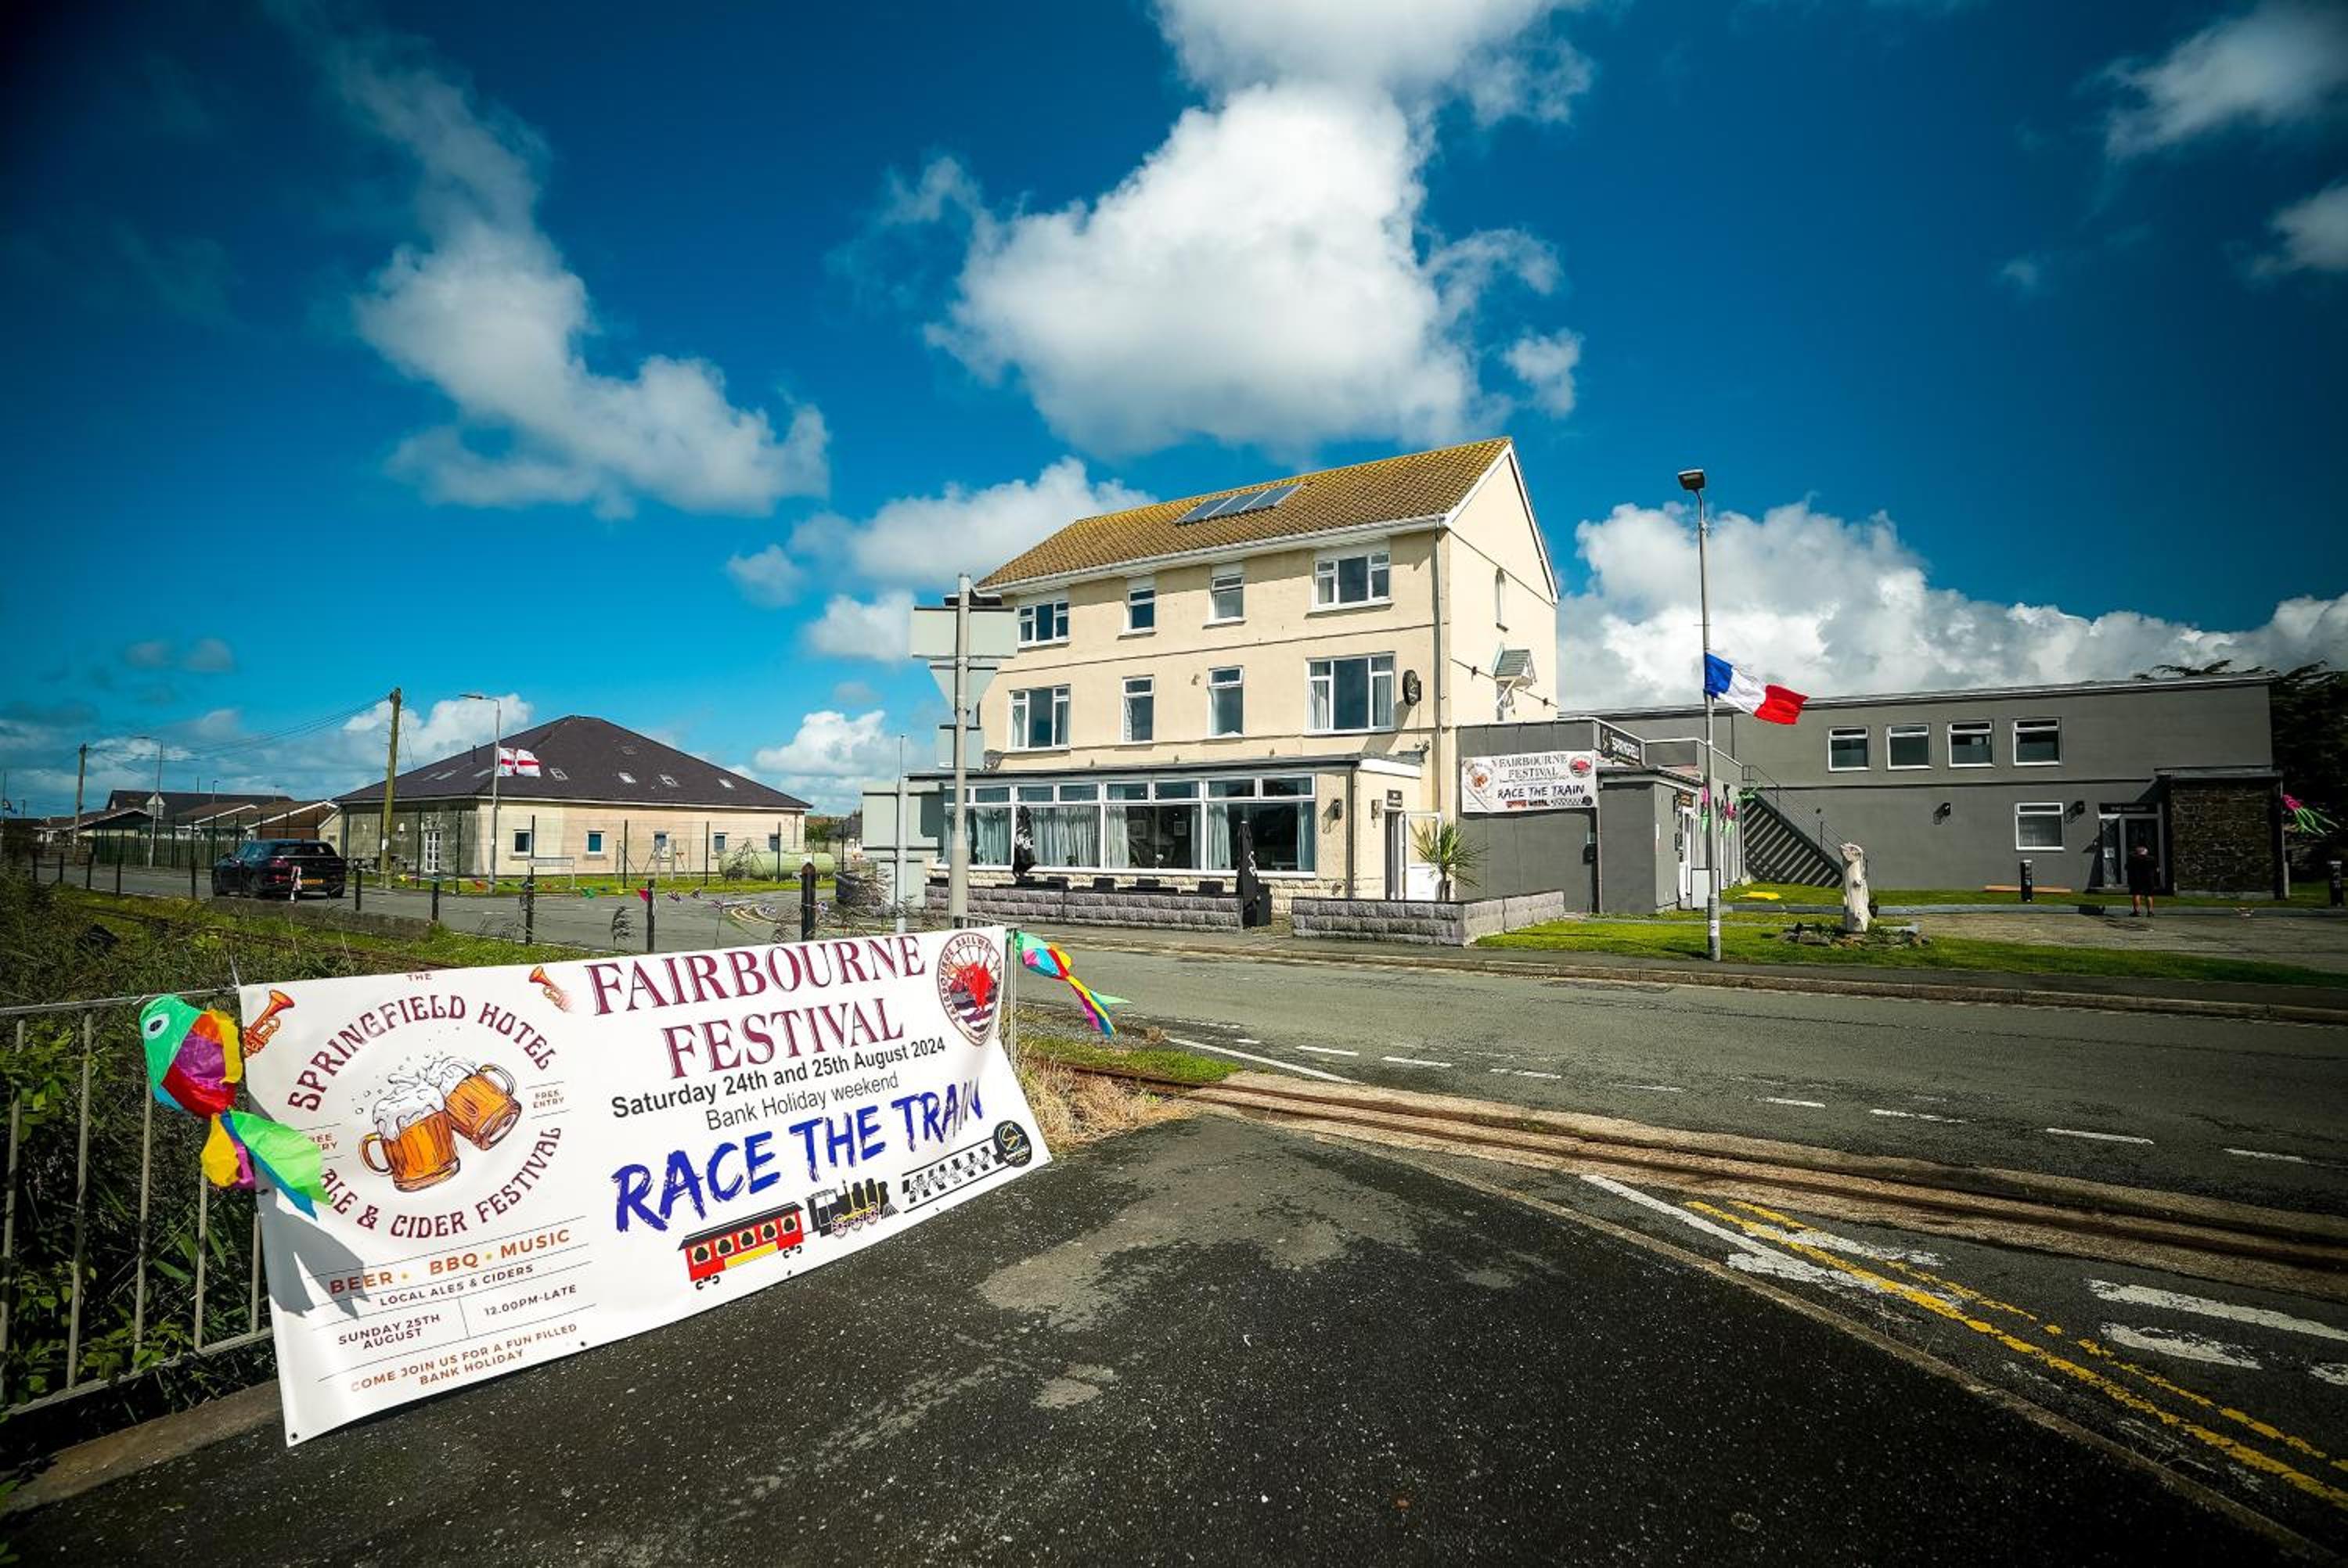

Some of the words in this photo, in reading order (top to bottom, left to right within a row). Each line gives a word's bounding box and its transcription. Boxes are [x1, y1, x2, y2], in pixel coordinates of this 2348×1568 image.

[1497, 754, 1568, 768] FAIRBOURNE
[1507, 767, 1558, 779] FESTIVAL
[1497, 788, 1525, 800] RACE
[1529, 786, 1548, 797] THE
[1552, 785, 1585, 797] TRAIN
[406, 973, 432, 982] THE
[585, 935, 927, 1016] FAIRBOURNE
[287, 994, 466, 1112] SPRINGFIELD
[477, 1002, 556, 1070] HOTEL
[660, 997, 905, 1080] FESTIVAL
[535, 1088, 560, 1099] FREE
[611, 1082, 717, 1118] Saturday
[723, 1070, 769, 1095] 24th
[773, 1063, 808, 1085] and
[812, 1054, 850, 1078] 25th
[853, 1045, 909, 1070] August
[911, 1036, 946, 1058] 2024
[533, 1096, 564, 1108] ENTRY
[706, 1102, 758, 1130] Bank
[762, 1088, 827, 1117] Holiday
[830, 1071, 899, 1102] weekend
[610, 1131, 781, 1232] RACE
[788, 1105, 886, 1182] THE
[891, 1077, 984, 1153] TRAIN
[321, 1168, 358, 1214] ALE
[356, 1204, 380, 1230] &
[391, 1211, 468, 1239] CIDER
[475, 1127, 561, 1224] FESTIVAL
[330, 1271, 394, 1295] BEER
[429, 1253, 479, 1275] BBQ
[500, 1229, 571, 1259] MUSIC
[380, 1291, 426, 1306] LOCAL
[430, 1282, 465, 1296] ALES
[469, 1278, 477, 1288] &
[482, 1264, 534, 1284] CIDERS
[338, 1322, 402, 1345] SUNDAY
[405, 1314, 441, 1329] 25TH
[362, 1329, 423, 1350] AUGUST
[351, 1372, 396, 1392] COME
[400, 1360, 435, 1378] JOIN
[438, 1354, 458, 1366] US
[462, 1347, 489, 1361] FOR
[493, 1343, 503, 1354] A
[506, 1335, 533, 1350] FUN
[536, 1322, 578, 1342] FILLED
[419, 1368, 460, 1386] BANK
[464, 1349, 524, 1372] HOLIDAY
